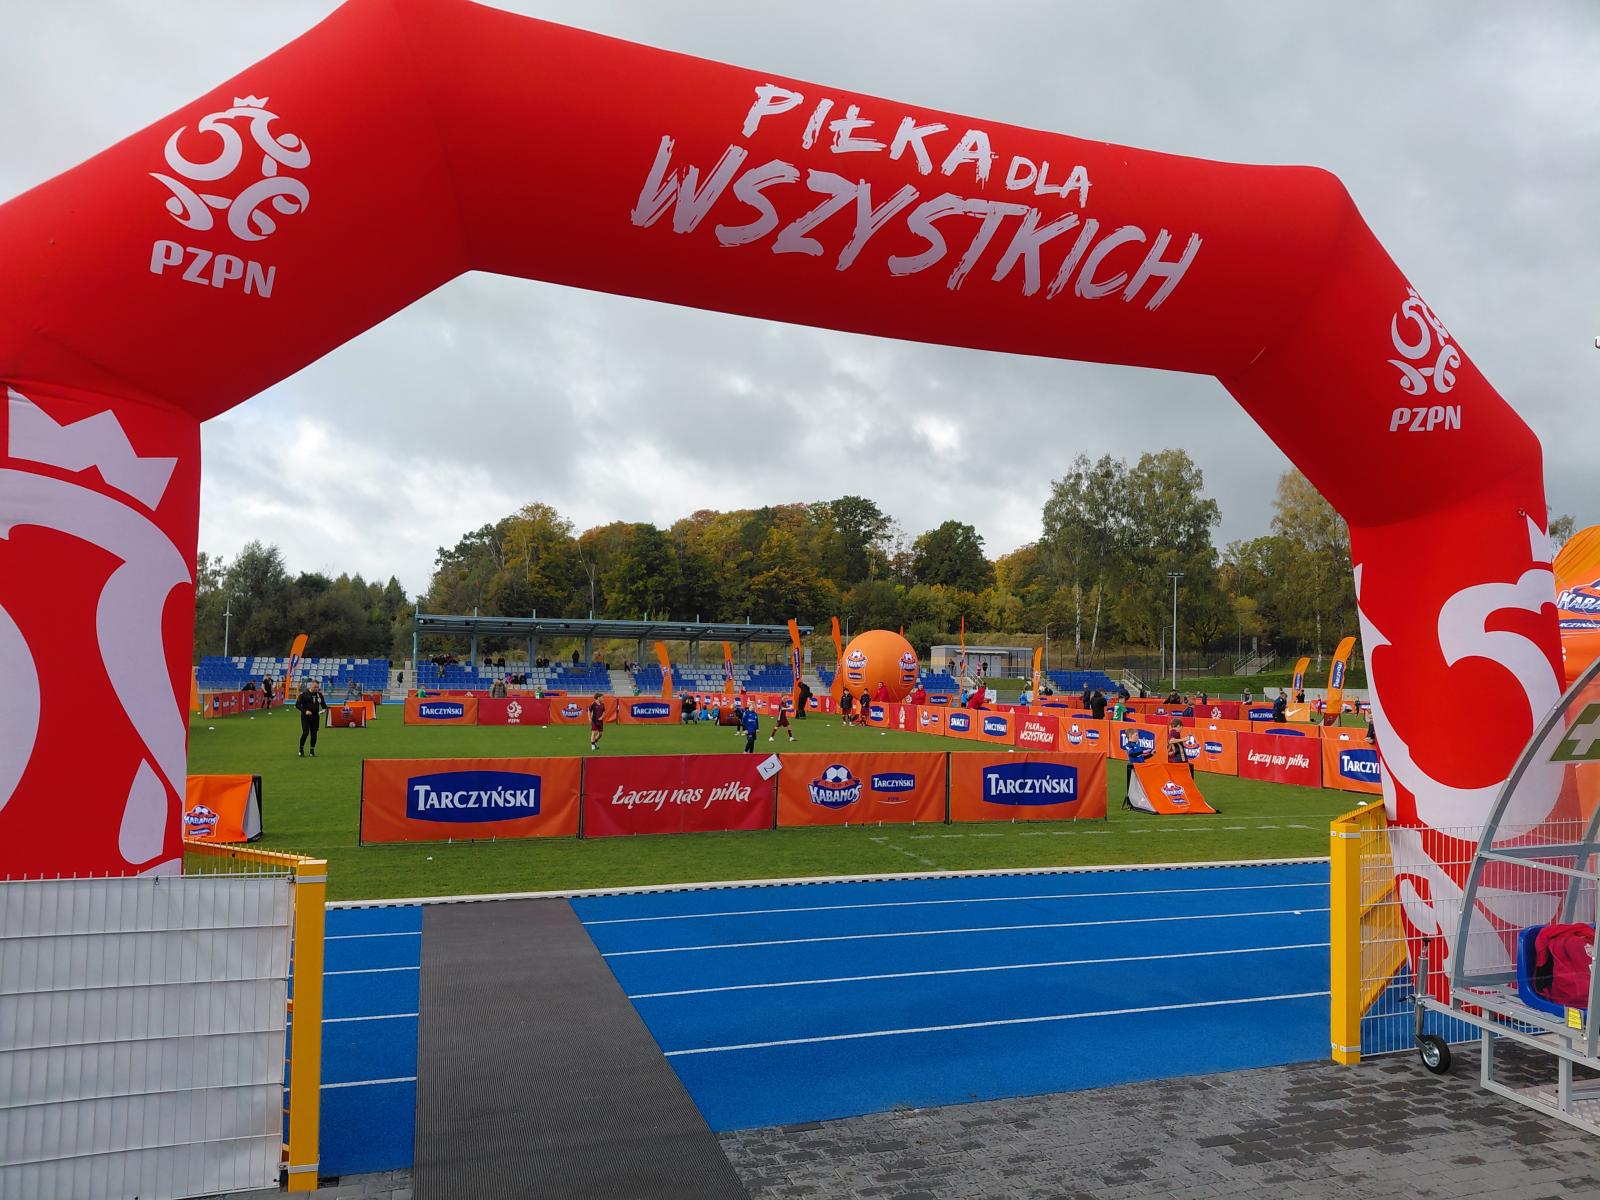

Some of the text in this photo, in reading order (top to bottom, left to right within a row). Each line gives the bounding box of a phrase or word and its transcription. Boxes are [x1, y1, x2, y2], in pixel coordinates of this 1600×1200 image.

[742, 83, 1092, 208] PIŁKA DLA
[630, 134, 1203, 312] WSZYSTKICH
[150, 239, 276, 298] PZPN
[1389, 404, 1461, 432] PZPN
[421, 706, 462, 715] TARCZYŃSKI
[633, 706, 669, 715] TARCZYŃSKI
[1121, 733, 1154, 749] TAYŃSKI
[763, 762, 775, 773] 2
[1247, 749, 1310, 770] Łączy nas piłka
[872, 777, 914, 788] TARCZYŃSKI
[987, 773, 1074, 795] TARCZYŃSKI
[413, 785, 535, 811] TARCZYŃSKI
[611, 781, 752, 811] Łączy nas piłka
[808, 784, 862, 803] KABANOS
